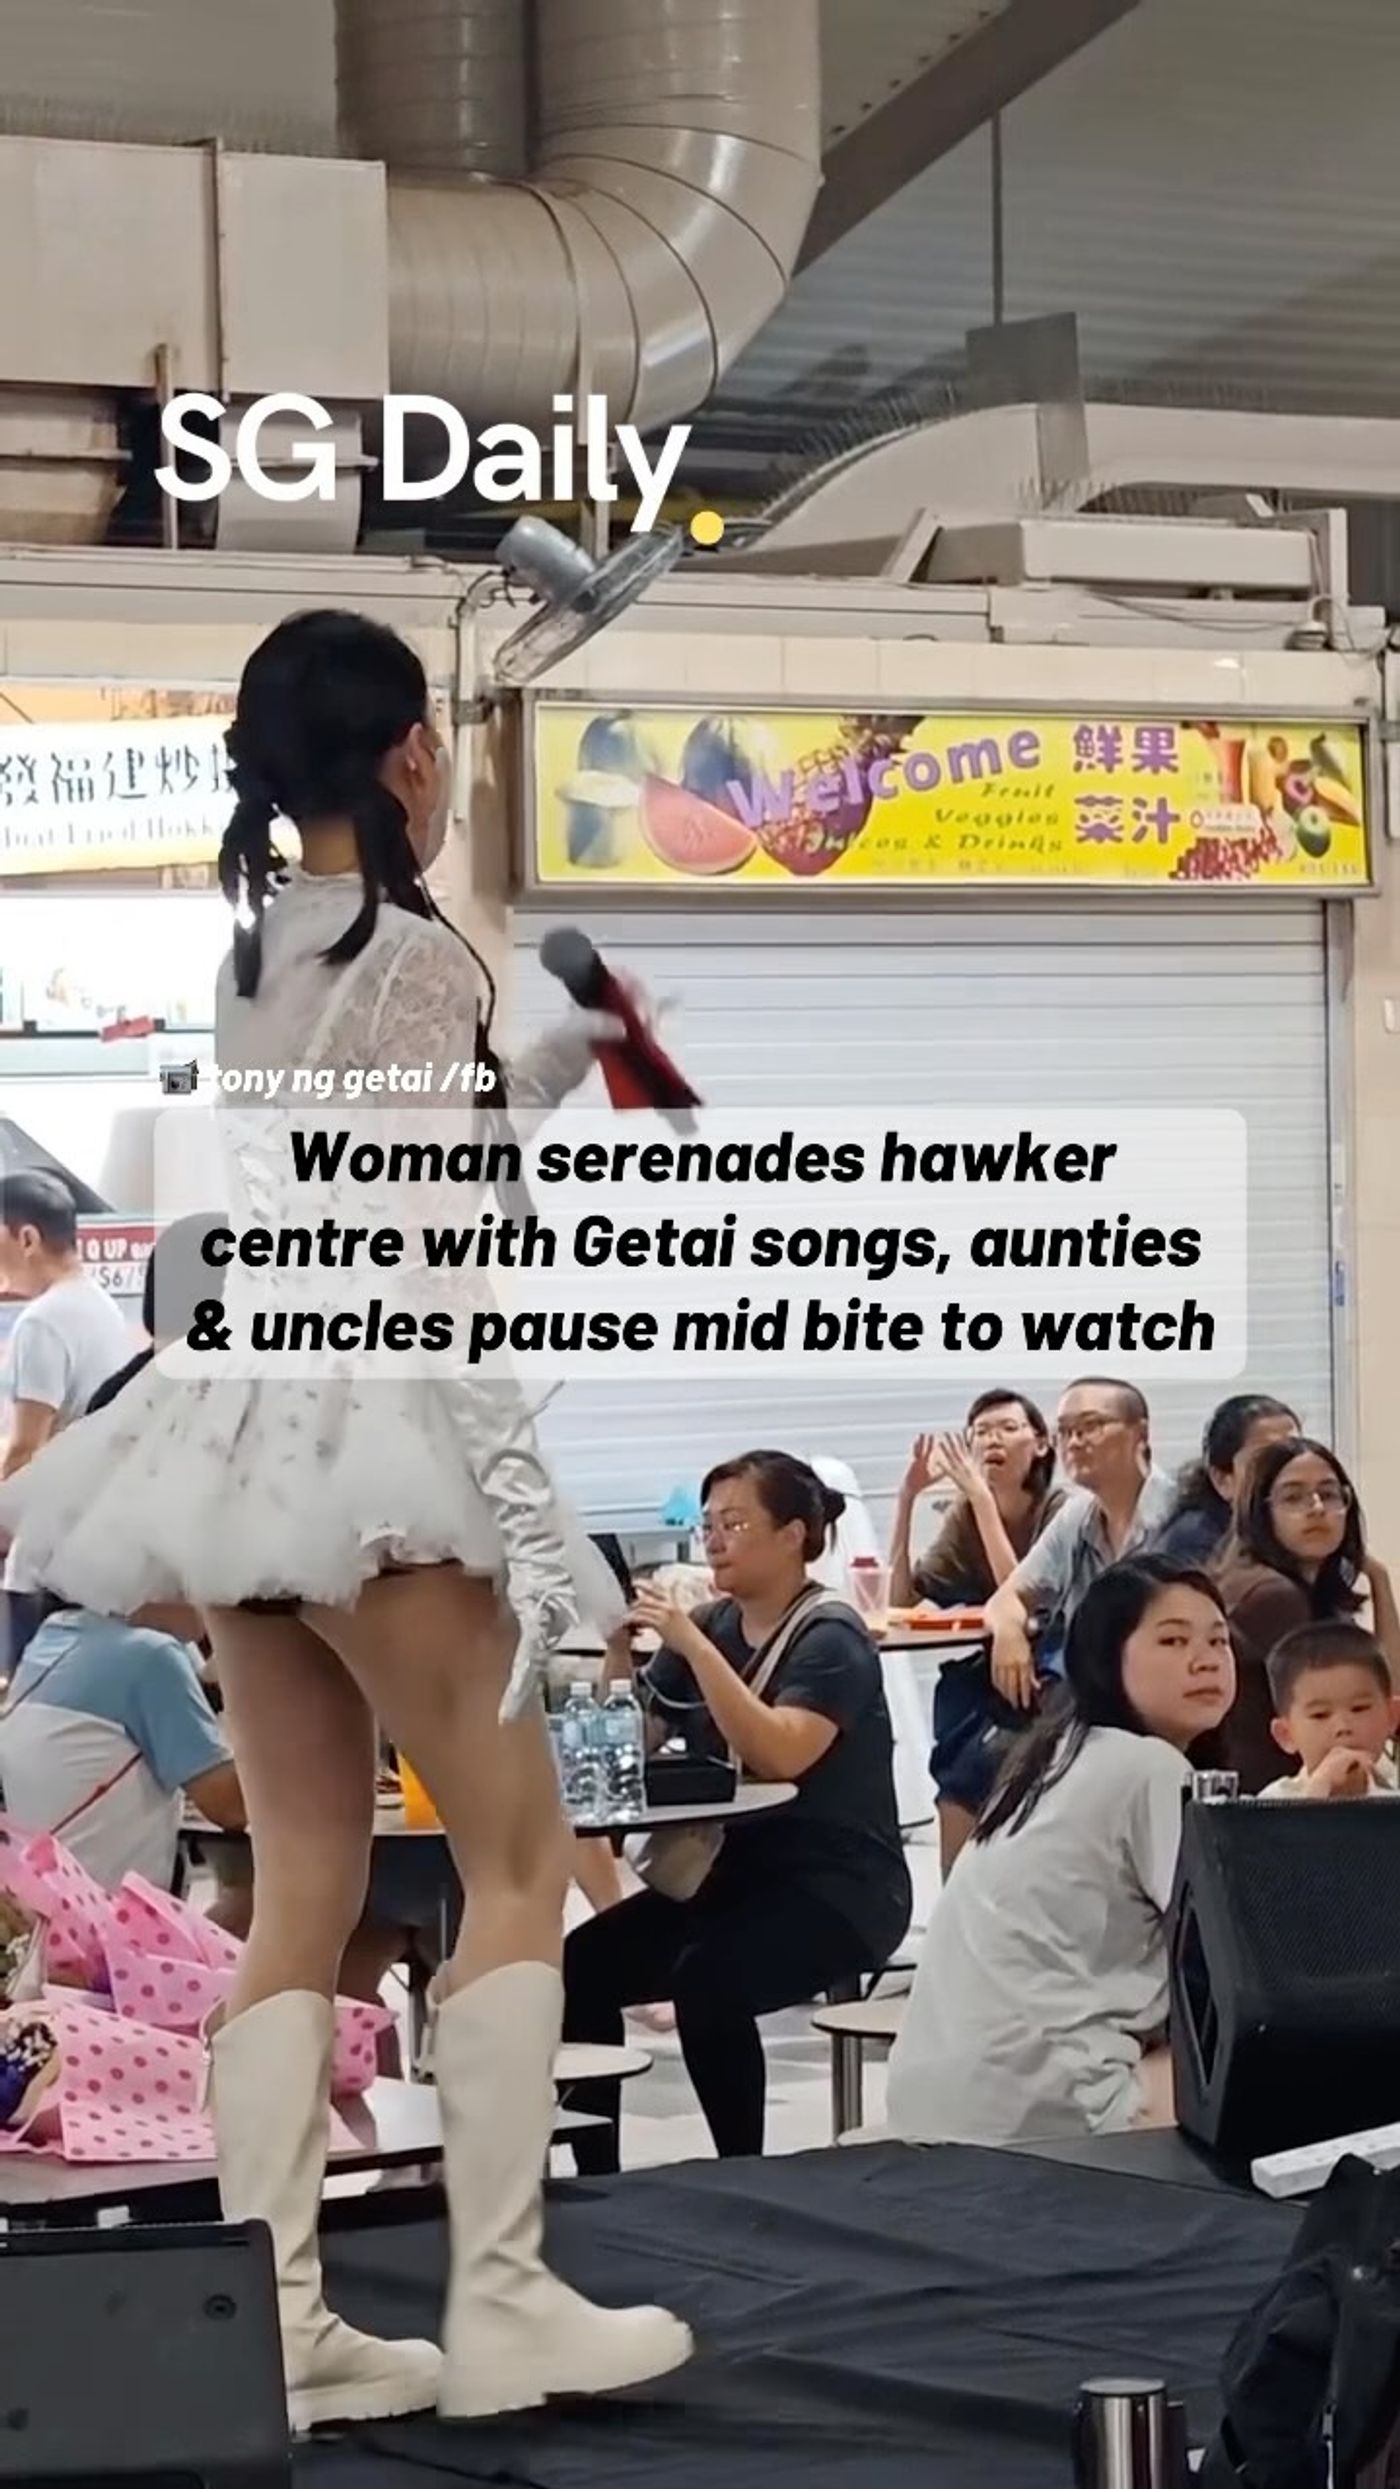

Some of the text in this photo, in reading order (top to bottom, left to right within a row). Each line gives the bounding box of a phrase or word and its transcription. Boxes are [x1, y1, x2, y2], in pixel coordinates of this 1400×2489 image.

[1072, 724, 1180, 775] 鮮果
[725, 730, 1041, 829] Welcome
[980, 782, 1056, 799] Fruit
[935, 807, 1060, 828] Veggies
[1073, 795, 1182, 845] 菜汁
[923, 833, 943, 850] &
[958, 833, 1063, 854] Drinks
